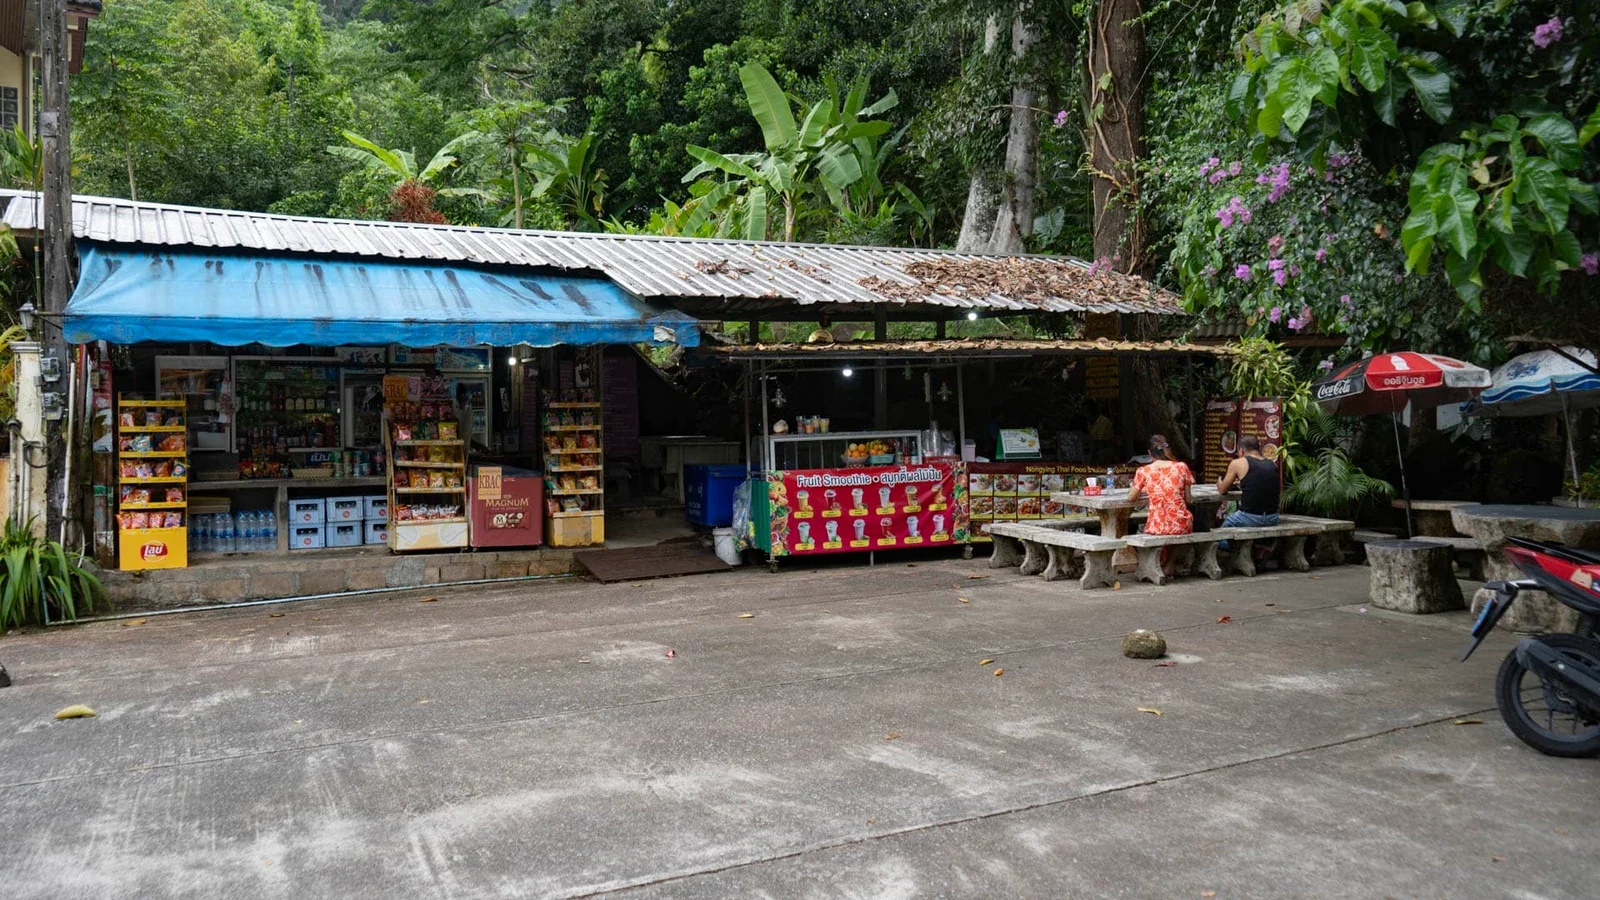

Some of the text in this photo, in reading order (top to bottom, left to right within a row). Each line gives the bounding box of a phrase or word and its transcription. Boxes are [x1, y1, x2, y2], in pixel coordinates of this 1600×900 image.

[1317, 379, 1351, 398] Coca-Cola
[1056, 465, 1070, 473] Thai
[797, 475, 821, 487] Fruit
[823, 473, 871, 486] Smoothie
[485, 497, 530, 507] MAGNUM
